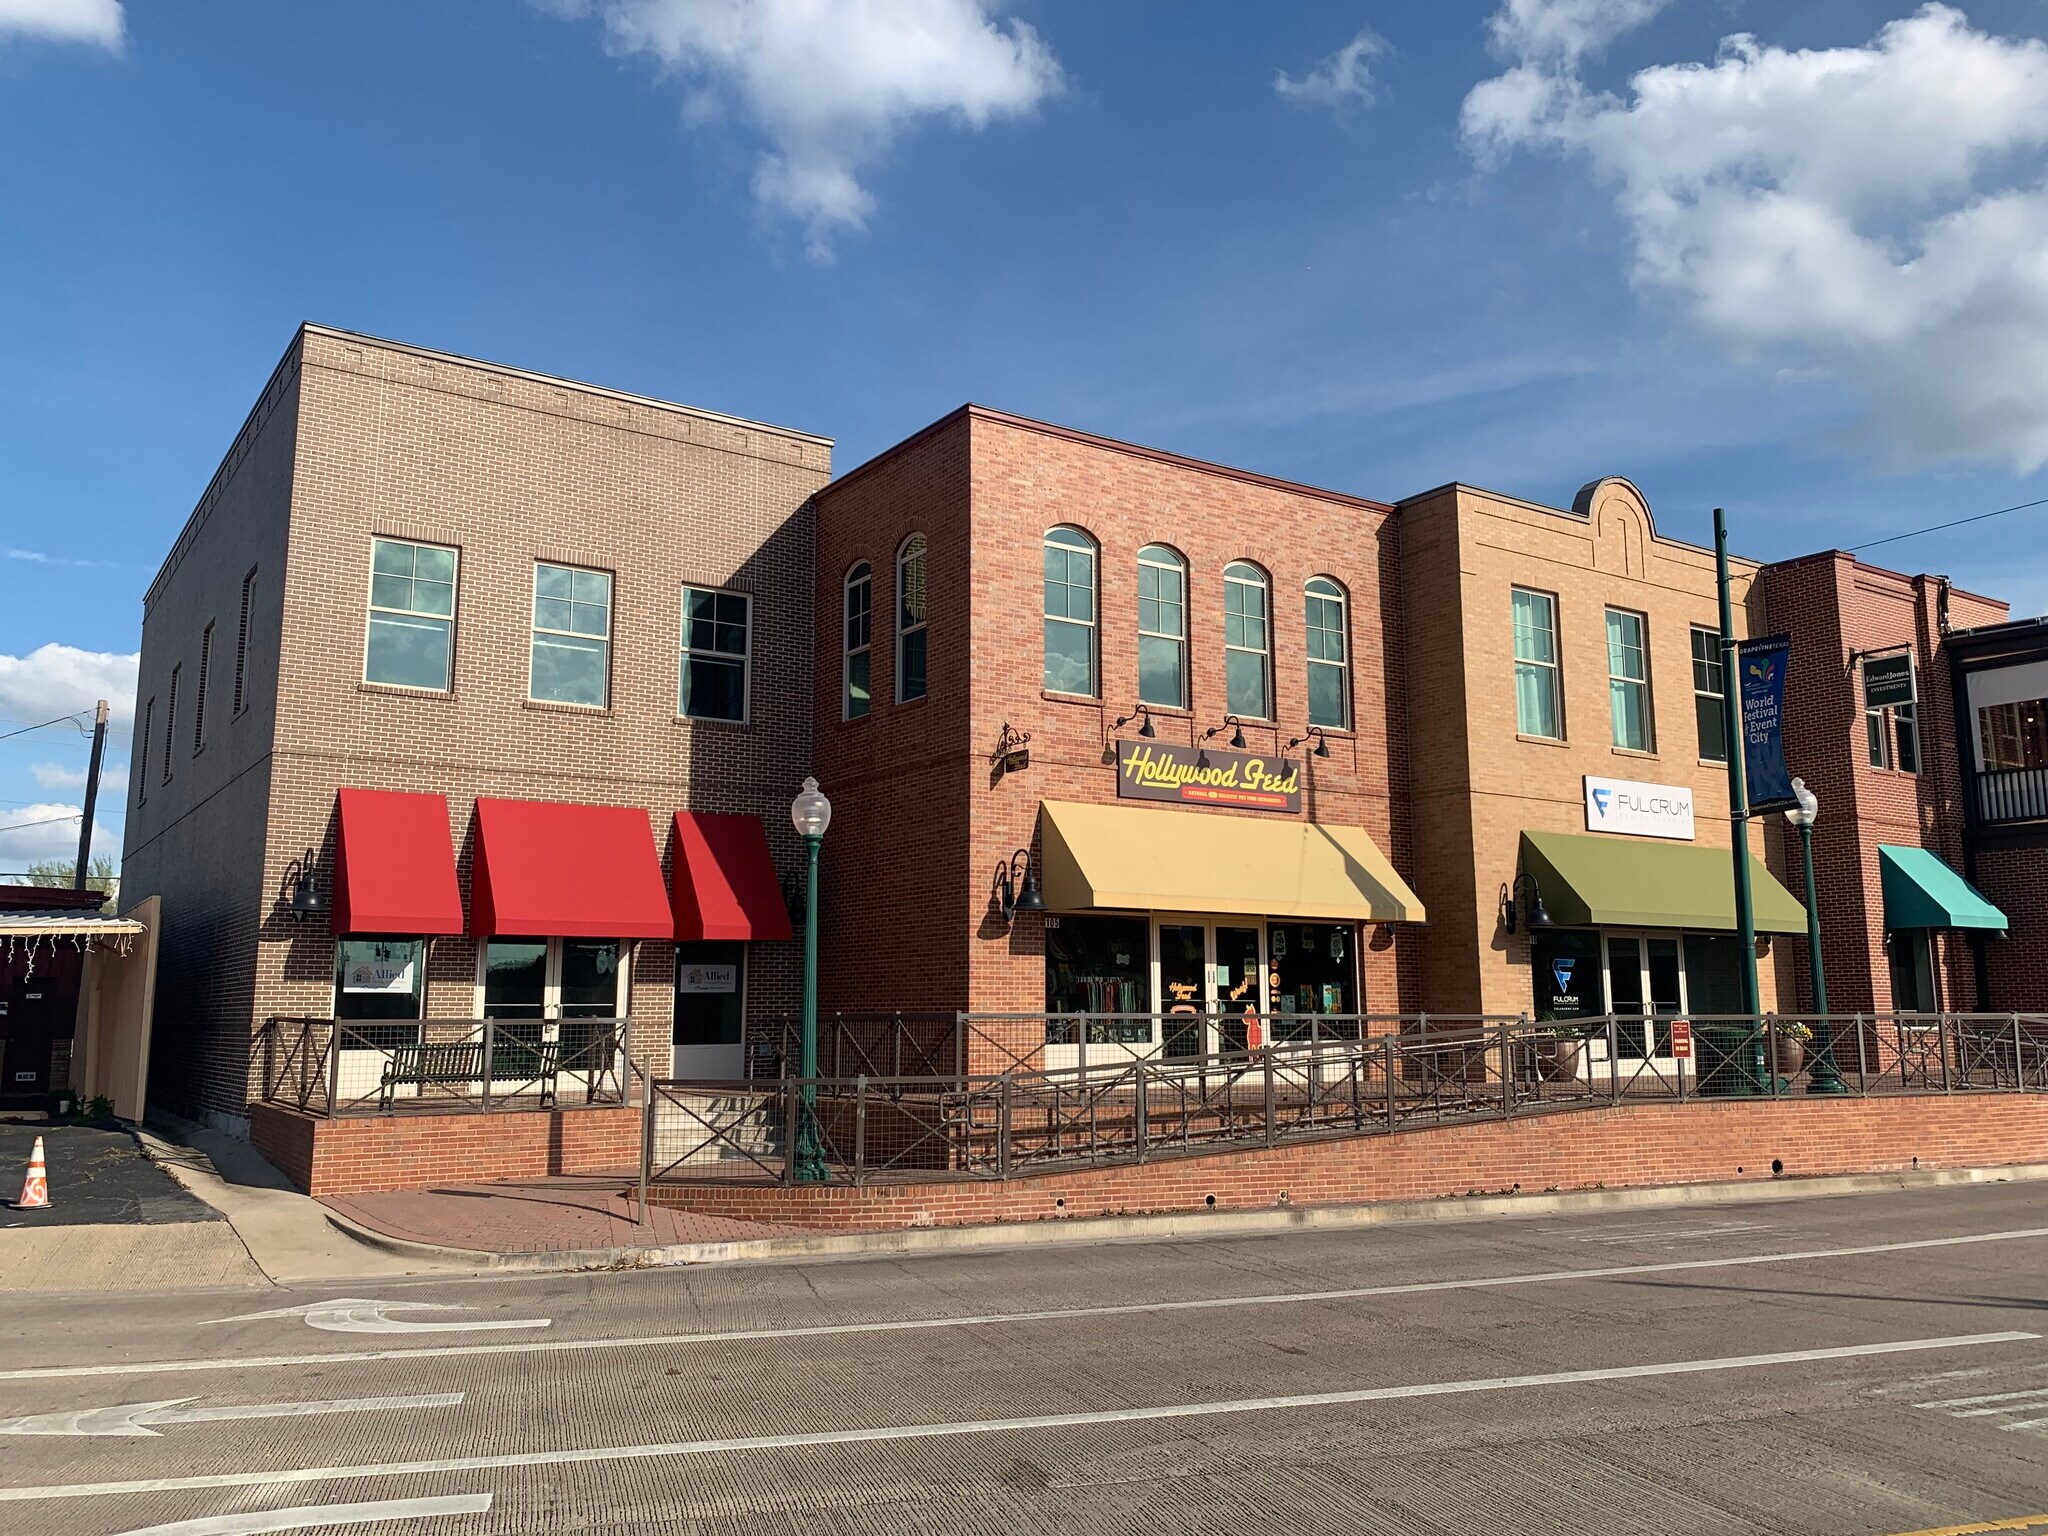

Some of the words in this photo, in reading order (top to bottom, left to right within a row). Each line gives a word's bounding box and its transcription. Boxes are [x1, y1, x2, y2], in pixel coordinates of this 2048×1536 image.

[1866, 672, 1889, 682] Edward
[1890, 670, 1909, 679] Jones
[1871, 683, 1907, 693] INVESTMENTS
[1745, 695, 1774, 710] World
[1744, 705, 1778, 722] Festival
[1750, 717, 1777, 732] Event
[1750, 732, 1769, 744] City
[1123, 745, 1238, 788] Hollywood
[1239, 759, 1298, 793] Feed
[1618, 795, 1690, 816] FULCRUM
[1045, 917, 1060, 928] 105
[372, 968, 405, 979] Allied
[704, 971, 729, 980] Allied
